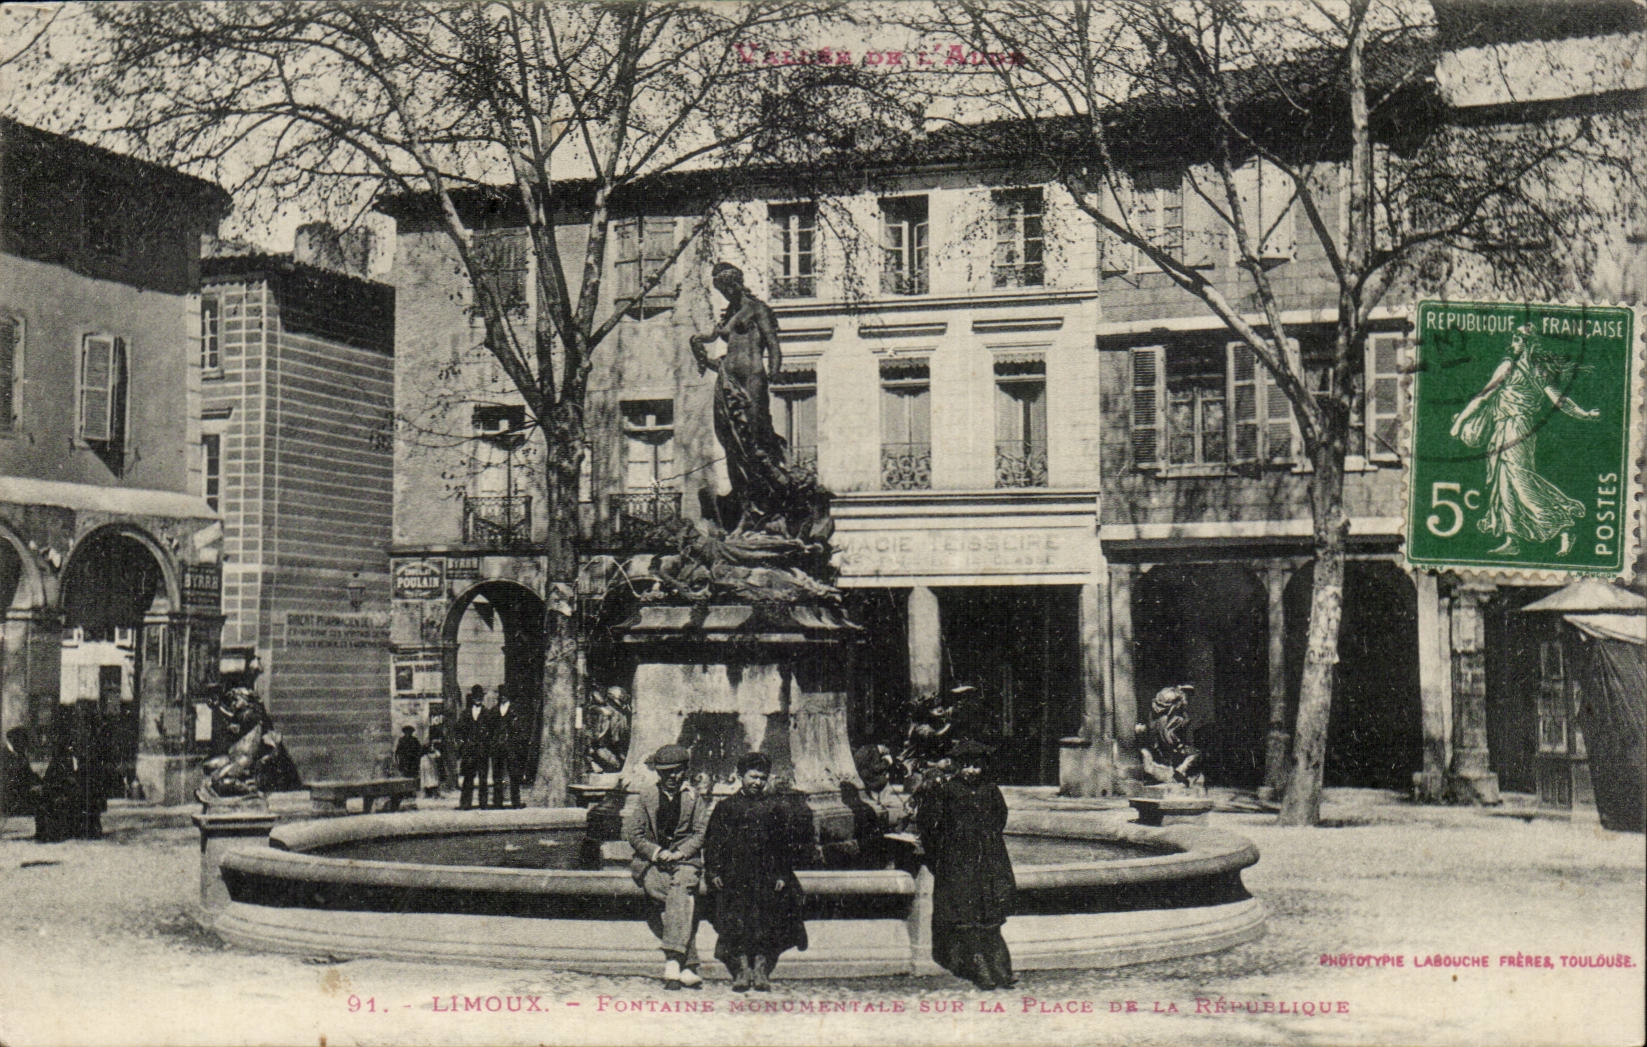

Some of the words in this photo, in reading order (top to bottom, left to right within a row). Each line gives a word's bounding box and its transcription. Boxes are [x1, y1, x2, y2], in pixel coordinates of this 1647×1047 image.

[1542, 316, 1623, 340] FRANÇAISE
[1595, 472, 1618, 556] POSTES
[184, 573, 219, 590] BYRRH
[396, 576, 440, 588] POULAIN
